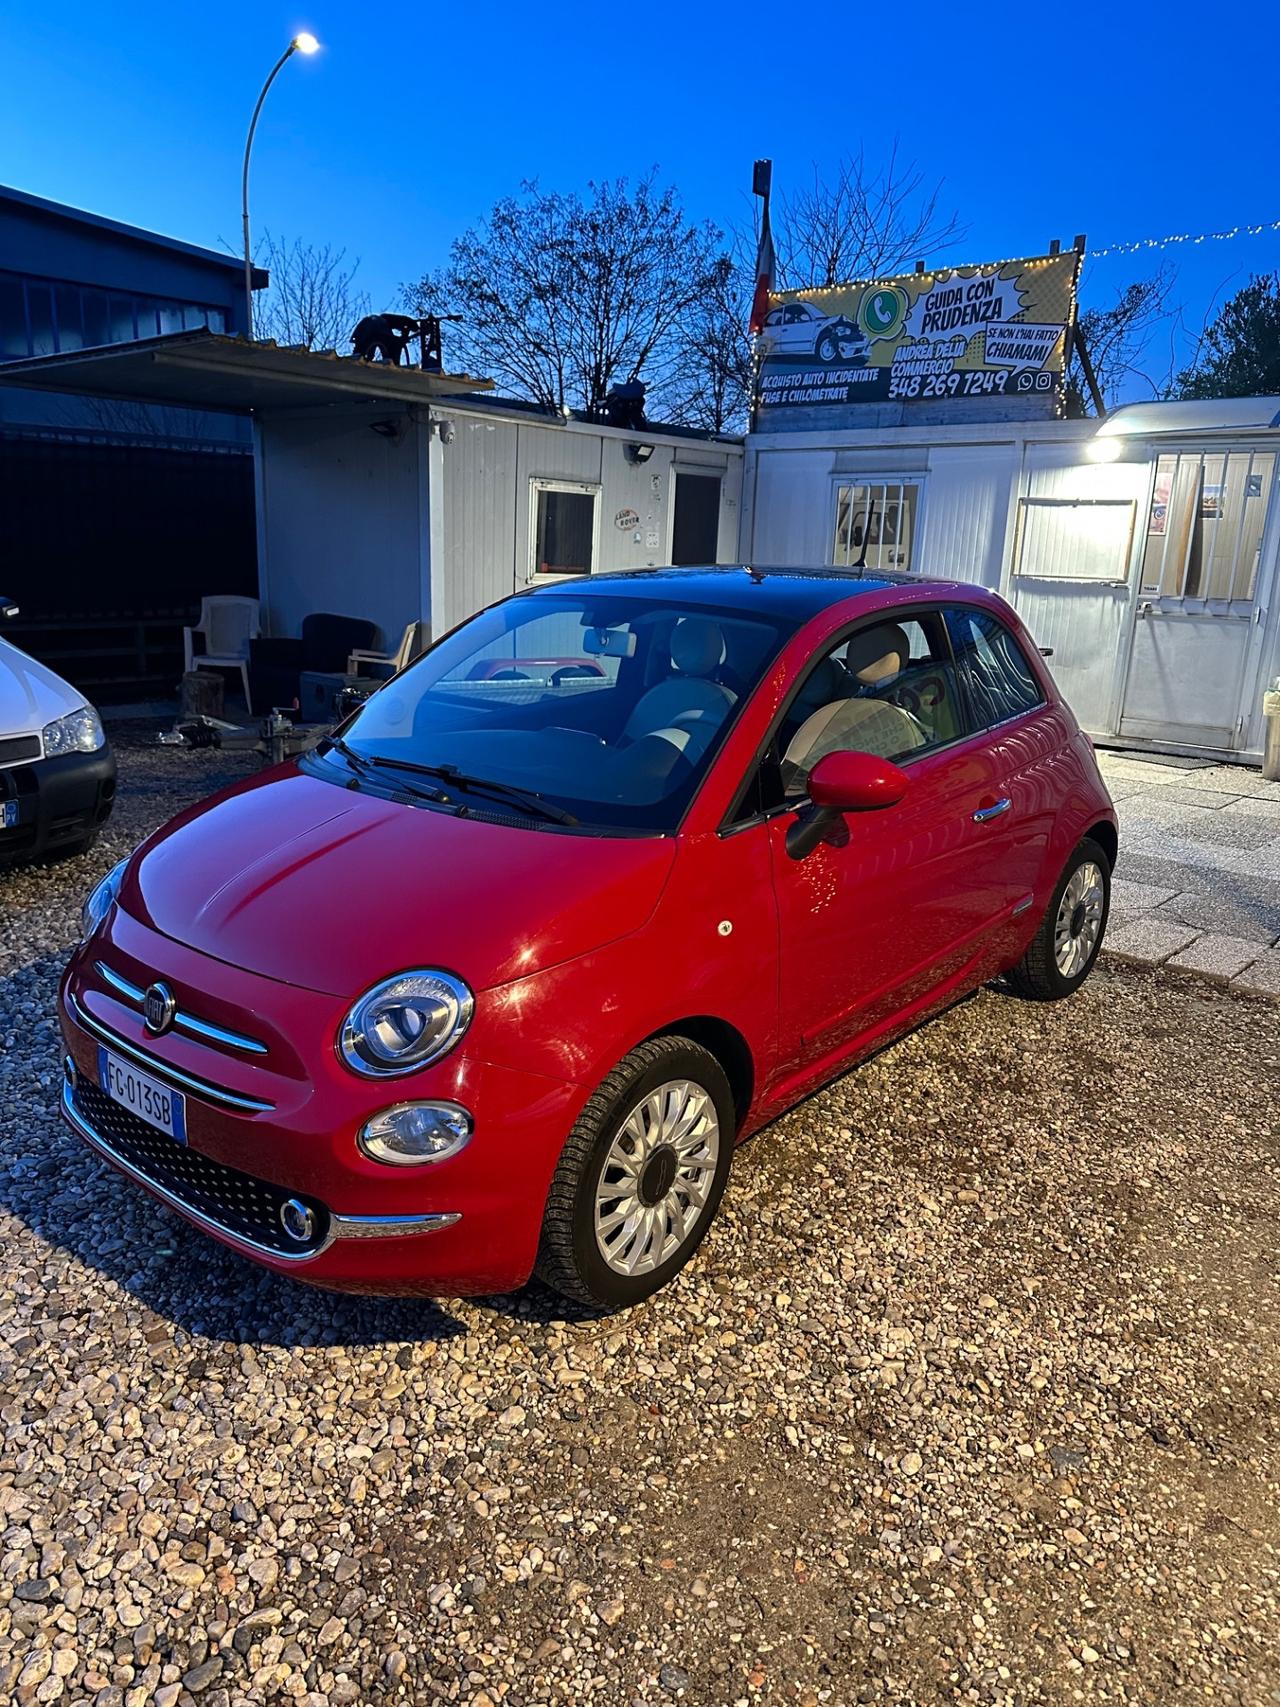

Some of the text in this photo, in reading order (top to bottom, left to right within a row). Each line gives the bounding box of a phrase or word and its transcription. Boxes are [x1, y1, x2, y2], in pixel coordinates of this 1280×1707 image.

[925, 279, 995, 312] GUIDA CON
[921, 297, 1002, 335] PRUDENZA
[987, 329, 999, 338] SE
[1000, 328, 1016, 339] NON
[1034, 329, 1058, 339] FATTO
[895, 342, 933, 362] ANDREA
[986, 342, 1049, 362] CHIAMAMI
[890, 358, 954, 377] COMMERCIO
[762, 368, 880, 388] ACQUISTO AUTO INCIDENTATE
[888, 371, 1009, 398] 348 269 7249
[761, 387, 849, 403] FUSE E CHILOMETRATE
[148, 997, 164, 1022] FIAT
